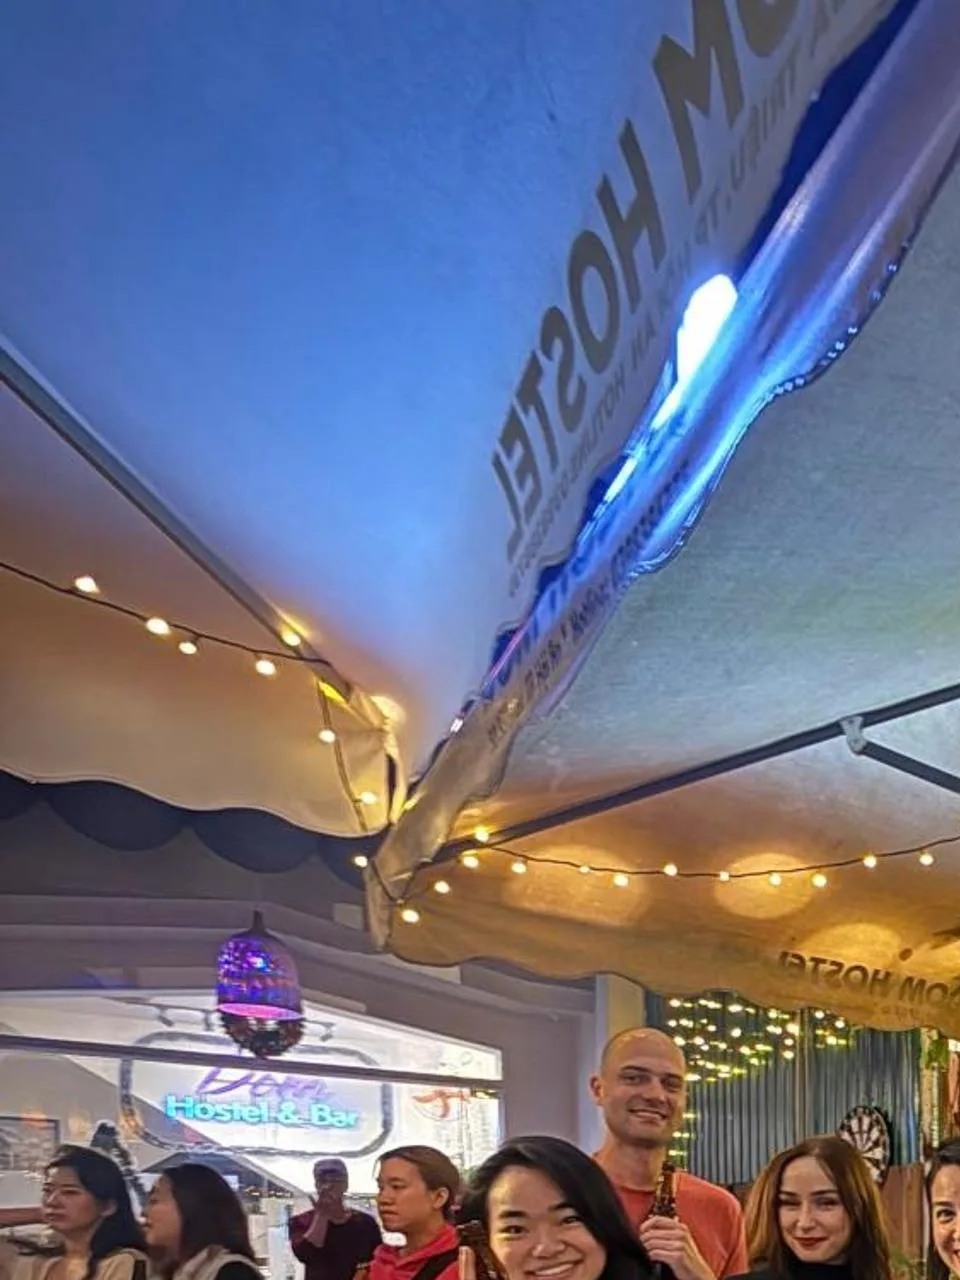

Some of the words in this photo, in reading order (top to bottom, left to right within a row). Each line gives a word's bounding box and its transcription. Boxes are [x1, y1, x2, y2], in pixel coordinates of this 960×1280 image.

[164, 1094, 268, 1124] Hostel
[277, 1100, 299, 1125] &
[309, 1102, 359, 1128] Bar
